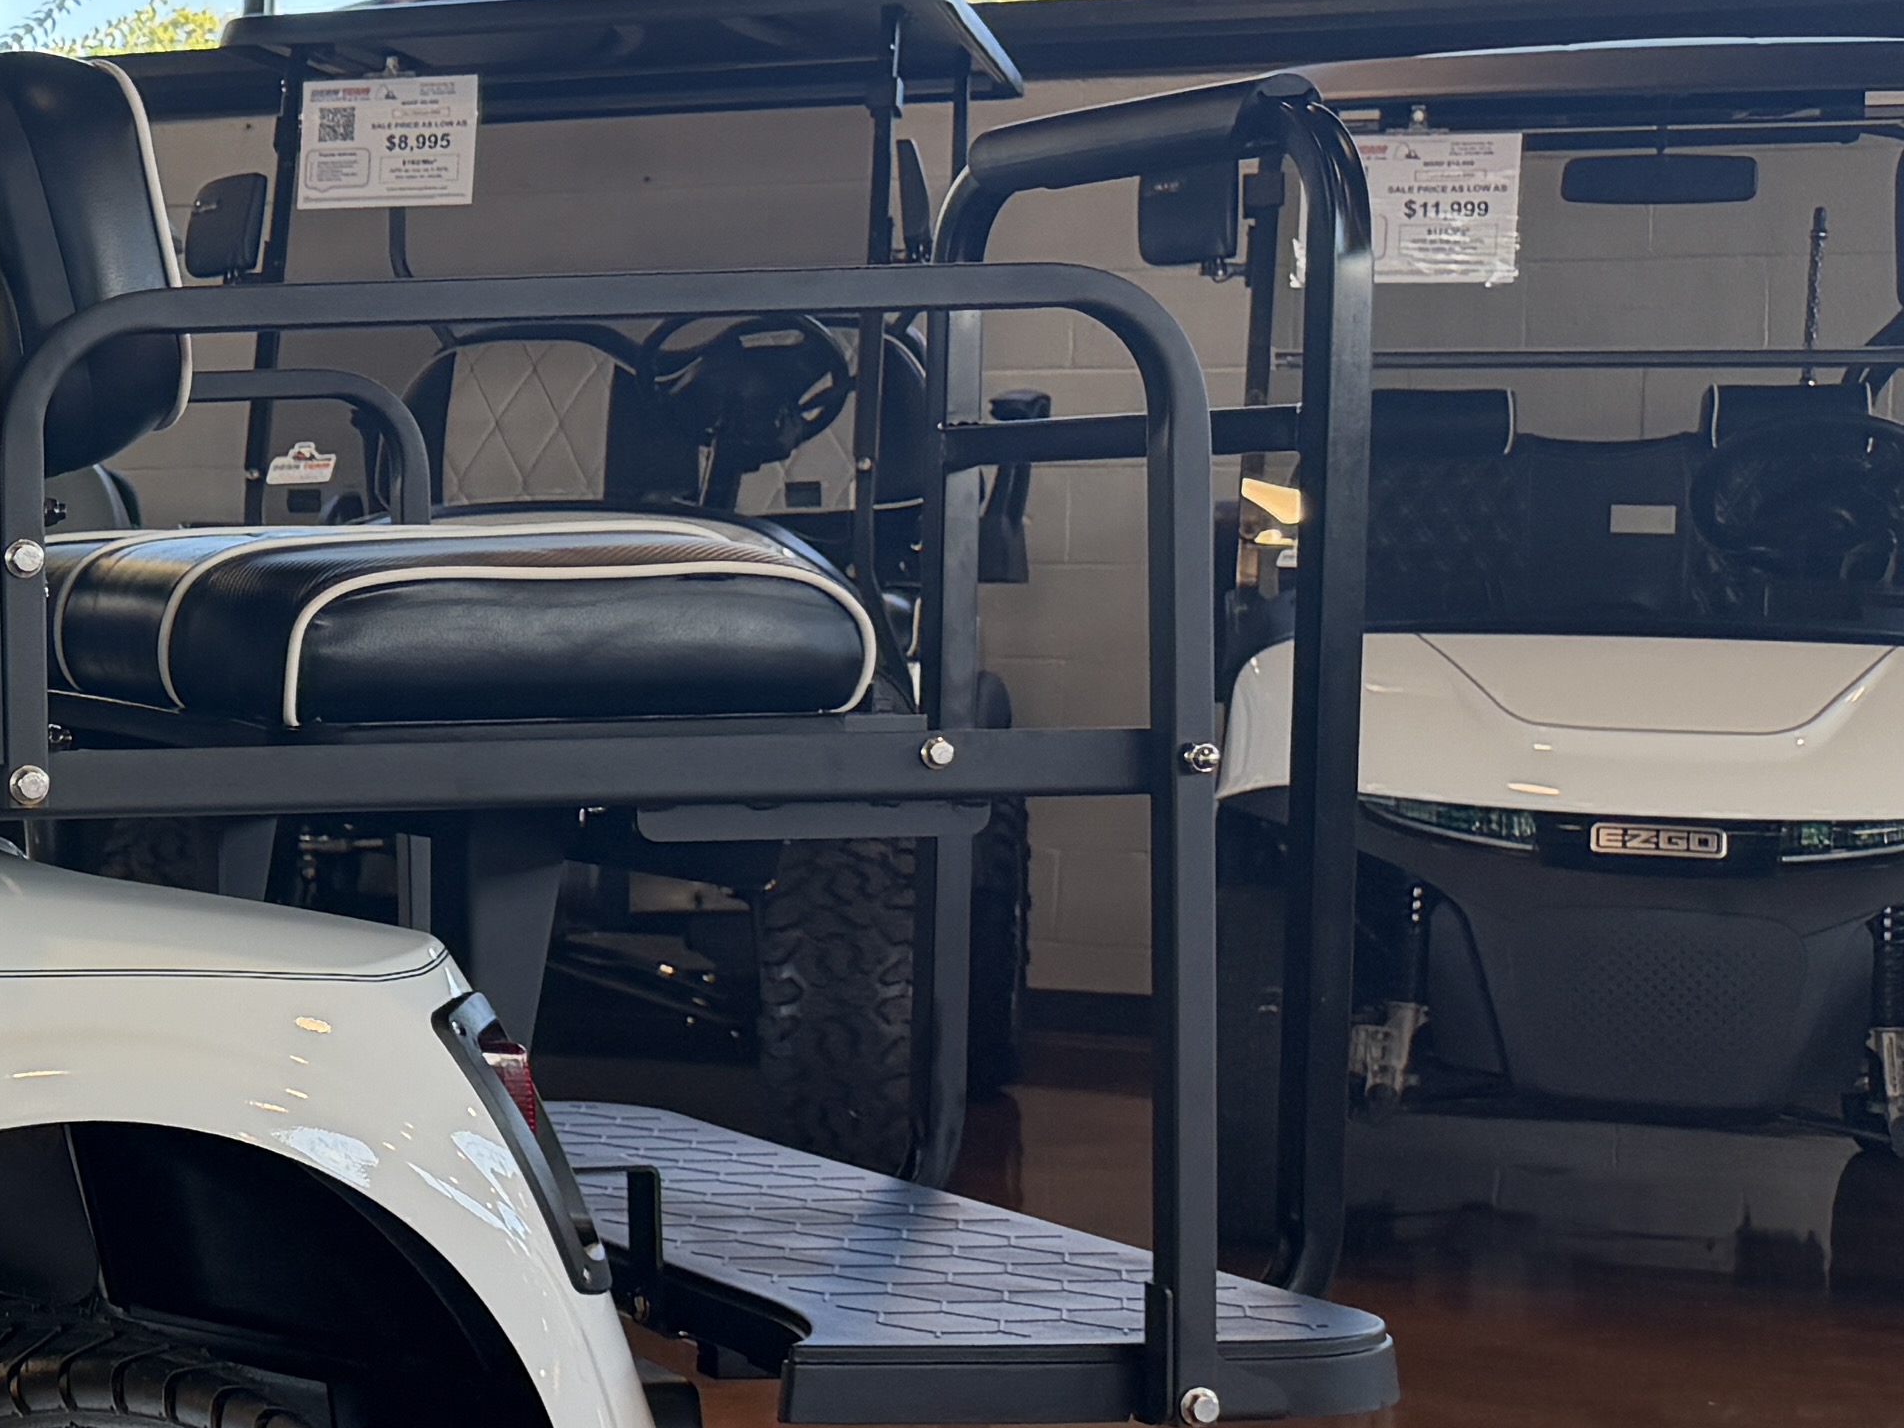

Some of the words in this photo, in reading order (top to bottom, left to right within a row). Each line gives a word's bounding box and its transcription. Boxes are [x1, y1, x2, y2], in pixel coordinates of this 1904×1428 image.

[385, 133, 451, 152] $8,995
[1388, 185, 1414, 194] SALE
[1417, 185, 1448, 194] PRICE
[1450, 184, 1464, 193] AS
[1467, 184, 1491, 193] LOW
[1403, 199, 1489, 221] $11,999
